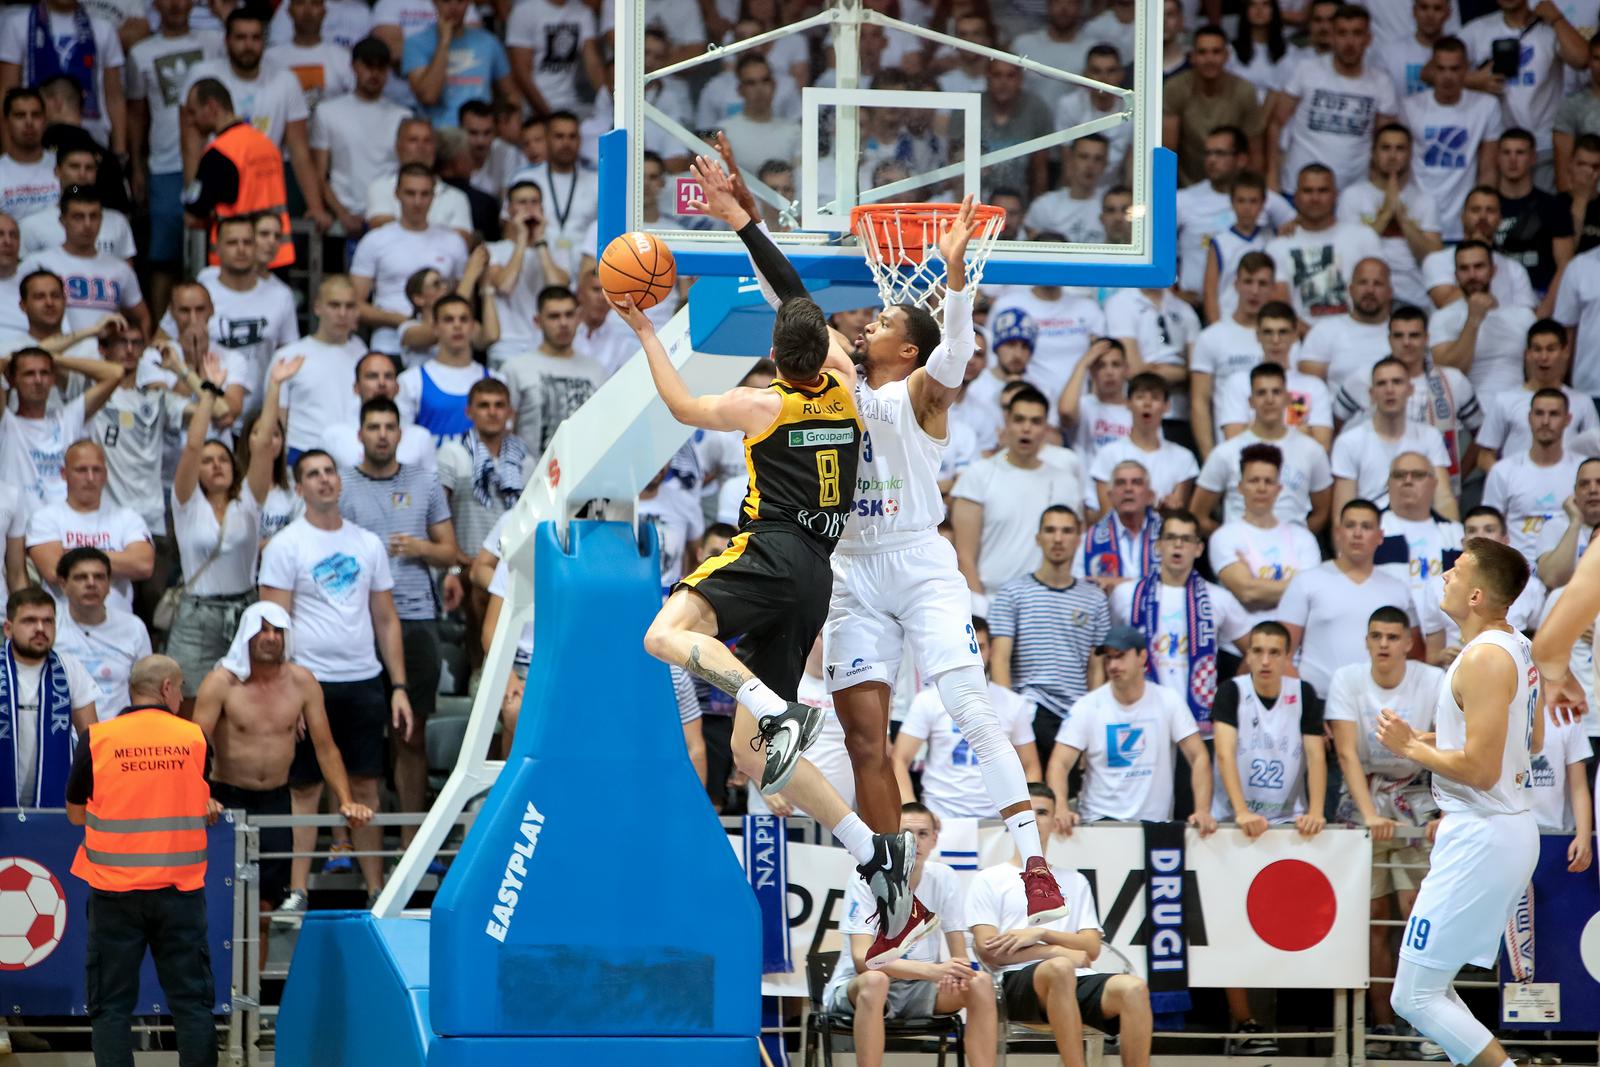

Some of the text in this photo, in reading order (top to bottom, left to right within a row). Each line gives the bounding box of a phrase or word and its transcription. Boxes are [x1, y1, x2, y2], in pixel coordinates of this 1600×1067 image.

[816, 449, 840, 507] 8
[846, 664, 873, 677] cromaris
[114, 745, 190, 759] MEDITERAN
[121, 759, 186, 773] SECURITY
[1249, 758, 1284, 789] 22
[485, 800, 546, 943] EASYPLAY
[1151, 848, 1184, 971] DRUGI
[1406, 915, 1431, 951] 19
